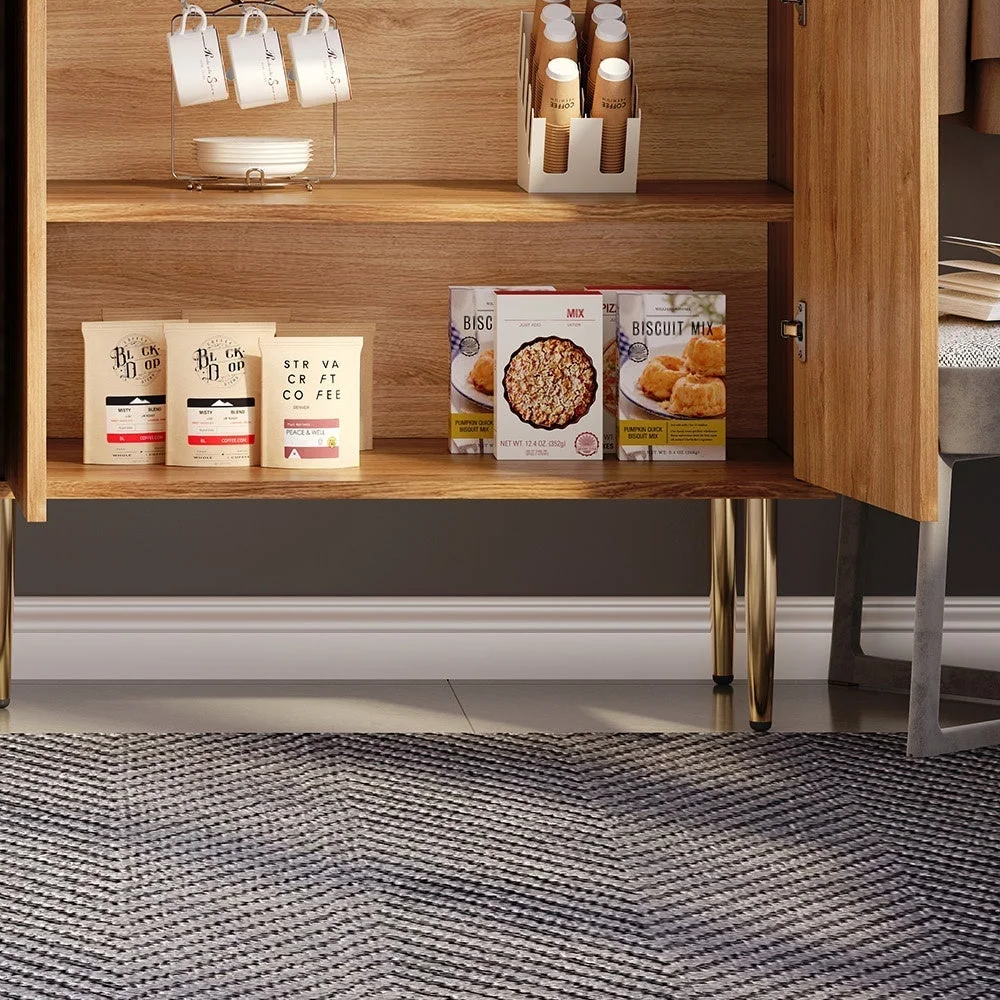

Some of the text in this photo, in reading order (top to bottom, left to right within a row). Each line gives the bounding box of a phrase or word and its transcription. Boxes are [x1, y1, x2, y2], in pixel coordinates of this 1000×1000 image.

[550, 101, 575, 110] COFFEE
[602, 101, 627, 110] COFFEE
[566, 308, 585, 318] MIX
[632, 321, 714, 336] BISCUIT MIX
